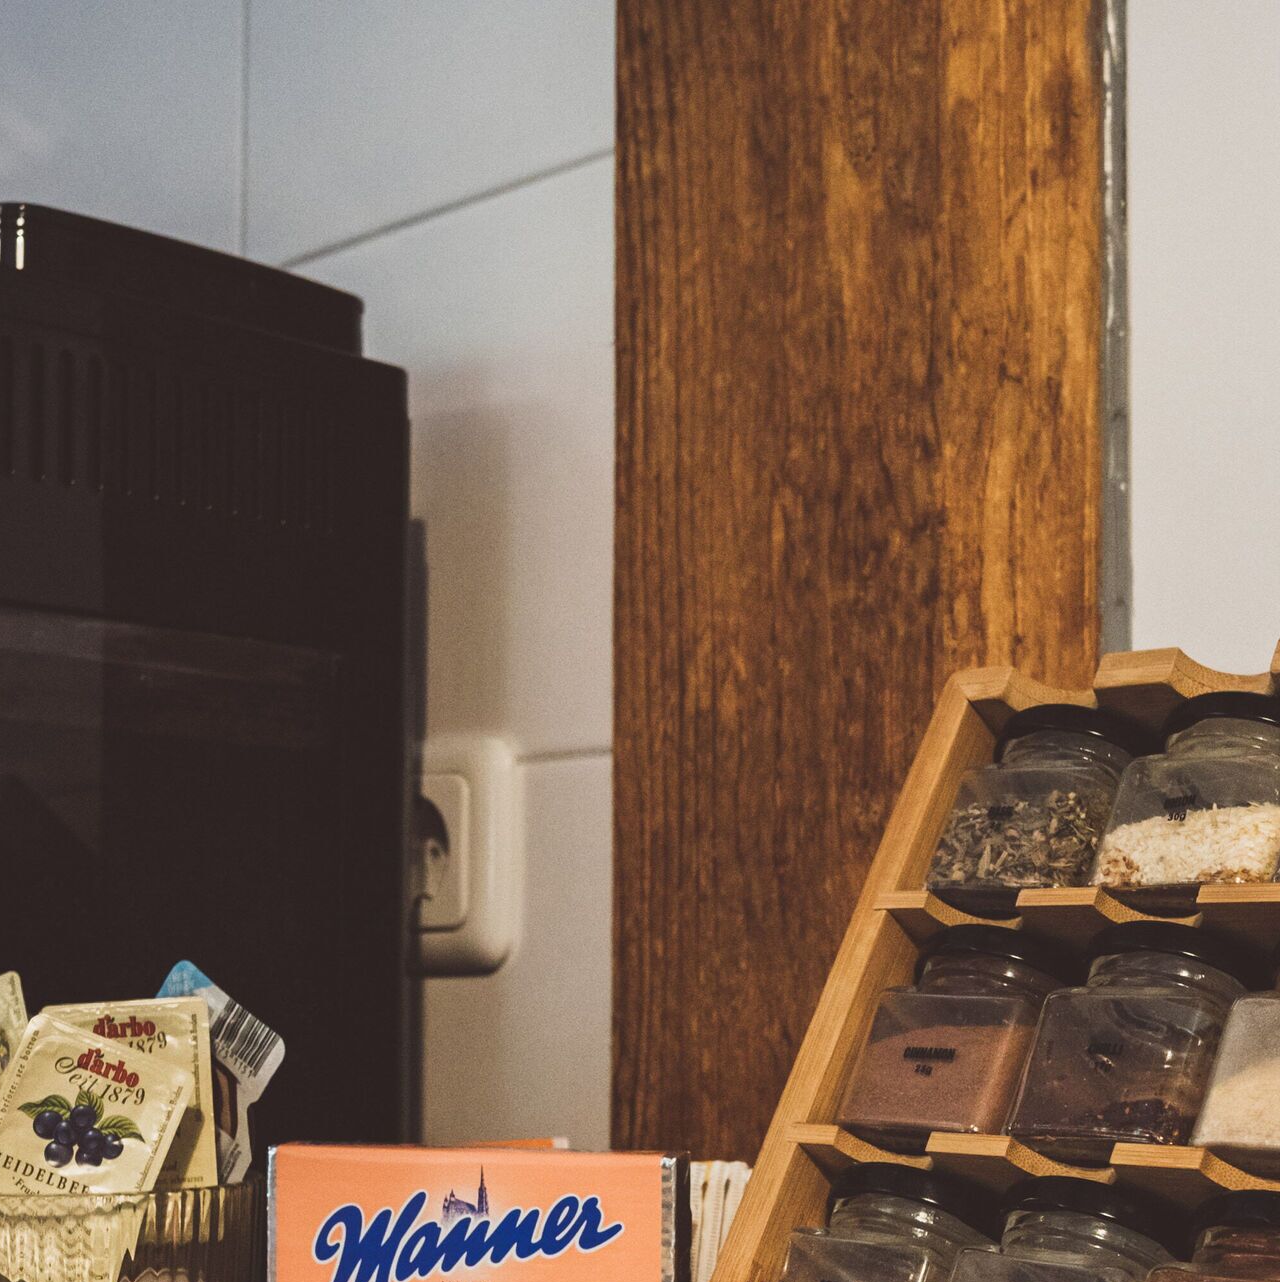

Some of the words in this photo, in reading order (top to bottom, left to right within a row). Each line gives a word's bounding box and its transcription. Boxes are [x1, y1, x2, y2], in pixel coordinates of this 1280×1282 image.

[1167, 811, 1186, 822] 30g
[903, 1046, 956, 1061] CINNAMON
[55, 1056, 99, 1093] Seit
[98, 1083, 145, 1106] 1879
